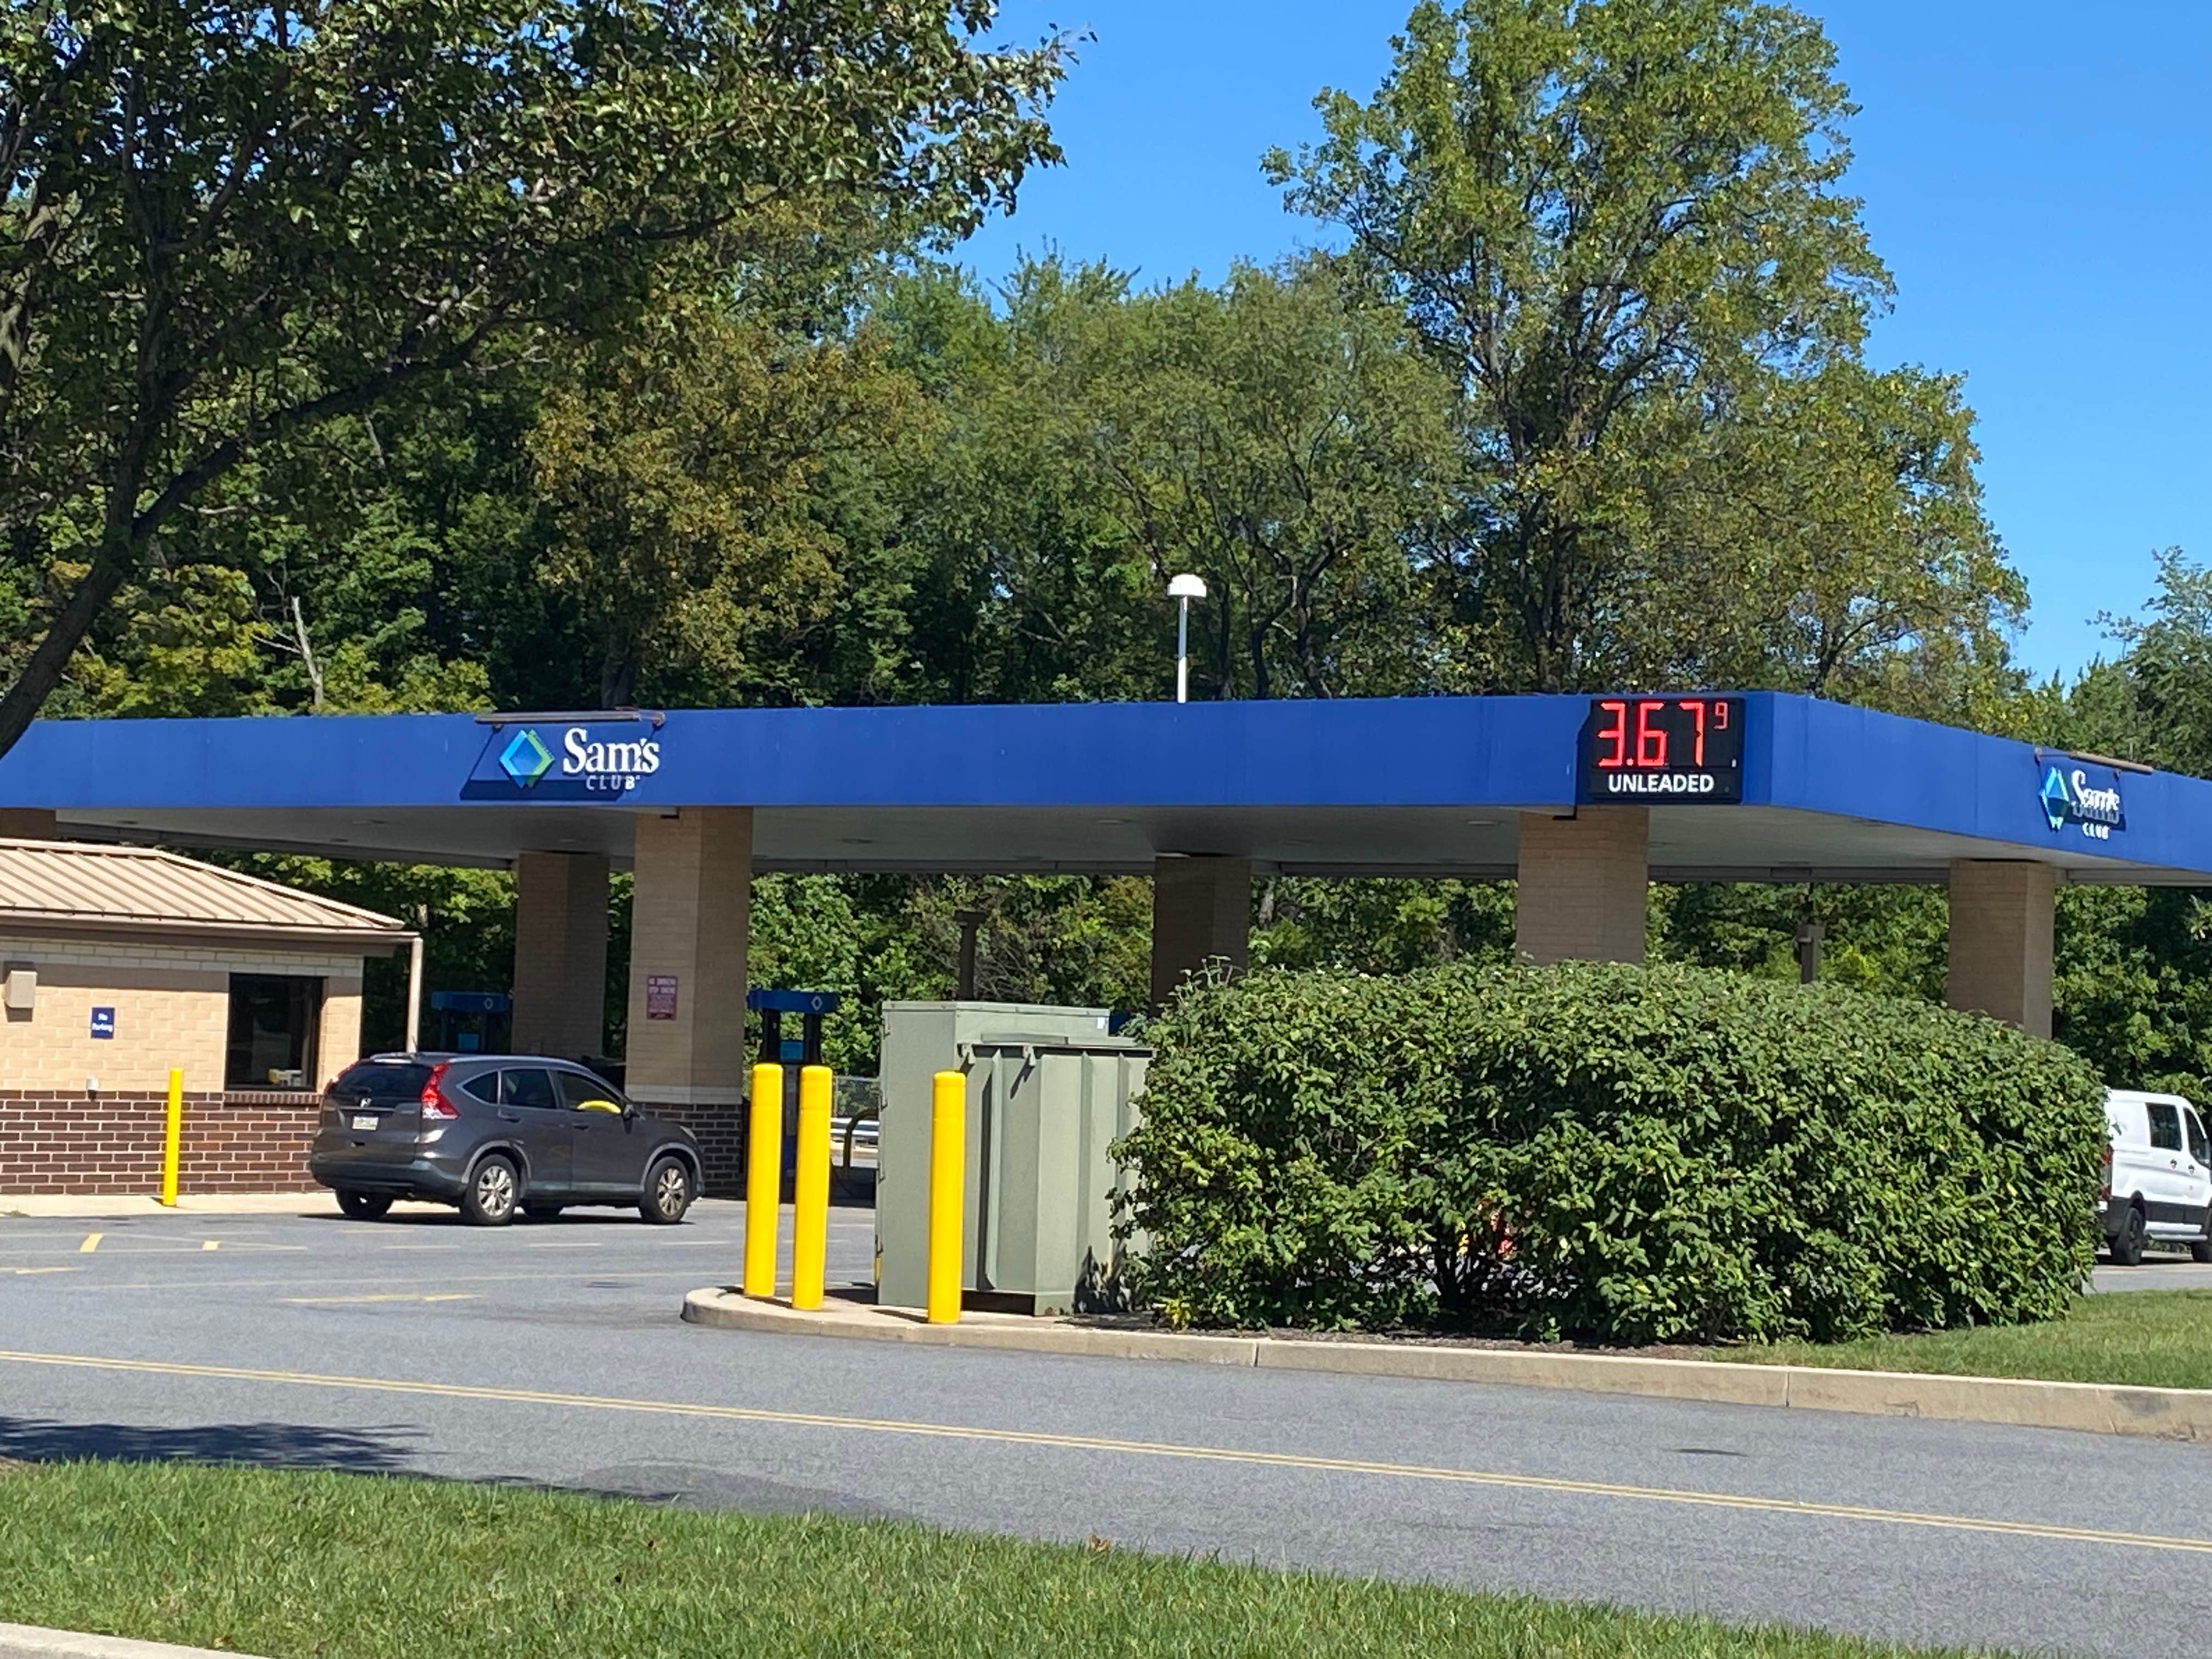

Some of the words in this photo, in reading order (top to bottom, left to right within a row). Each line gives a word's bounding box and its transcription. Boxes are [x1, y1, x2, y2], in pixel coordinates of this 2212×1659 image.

[563, 727, 660, 774] Sam's
[585, 775, 636, 791] CLUB
[1609, 774, 1714, 793] UNLEADED
[2082, 822, 2110, 840] CLUB
